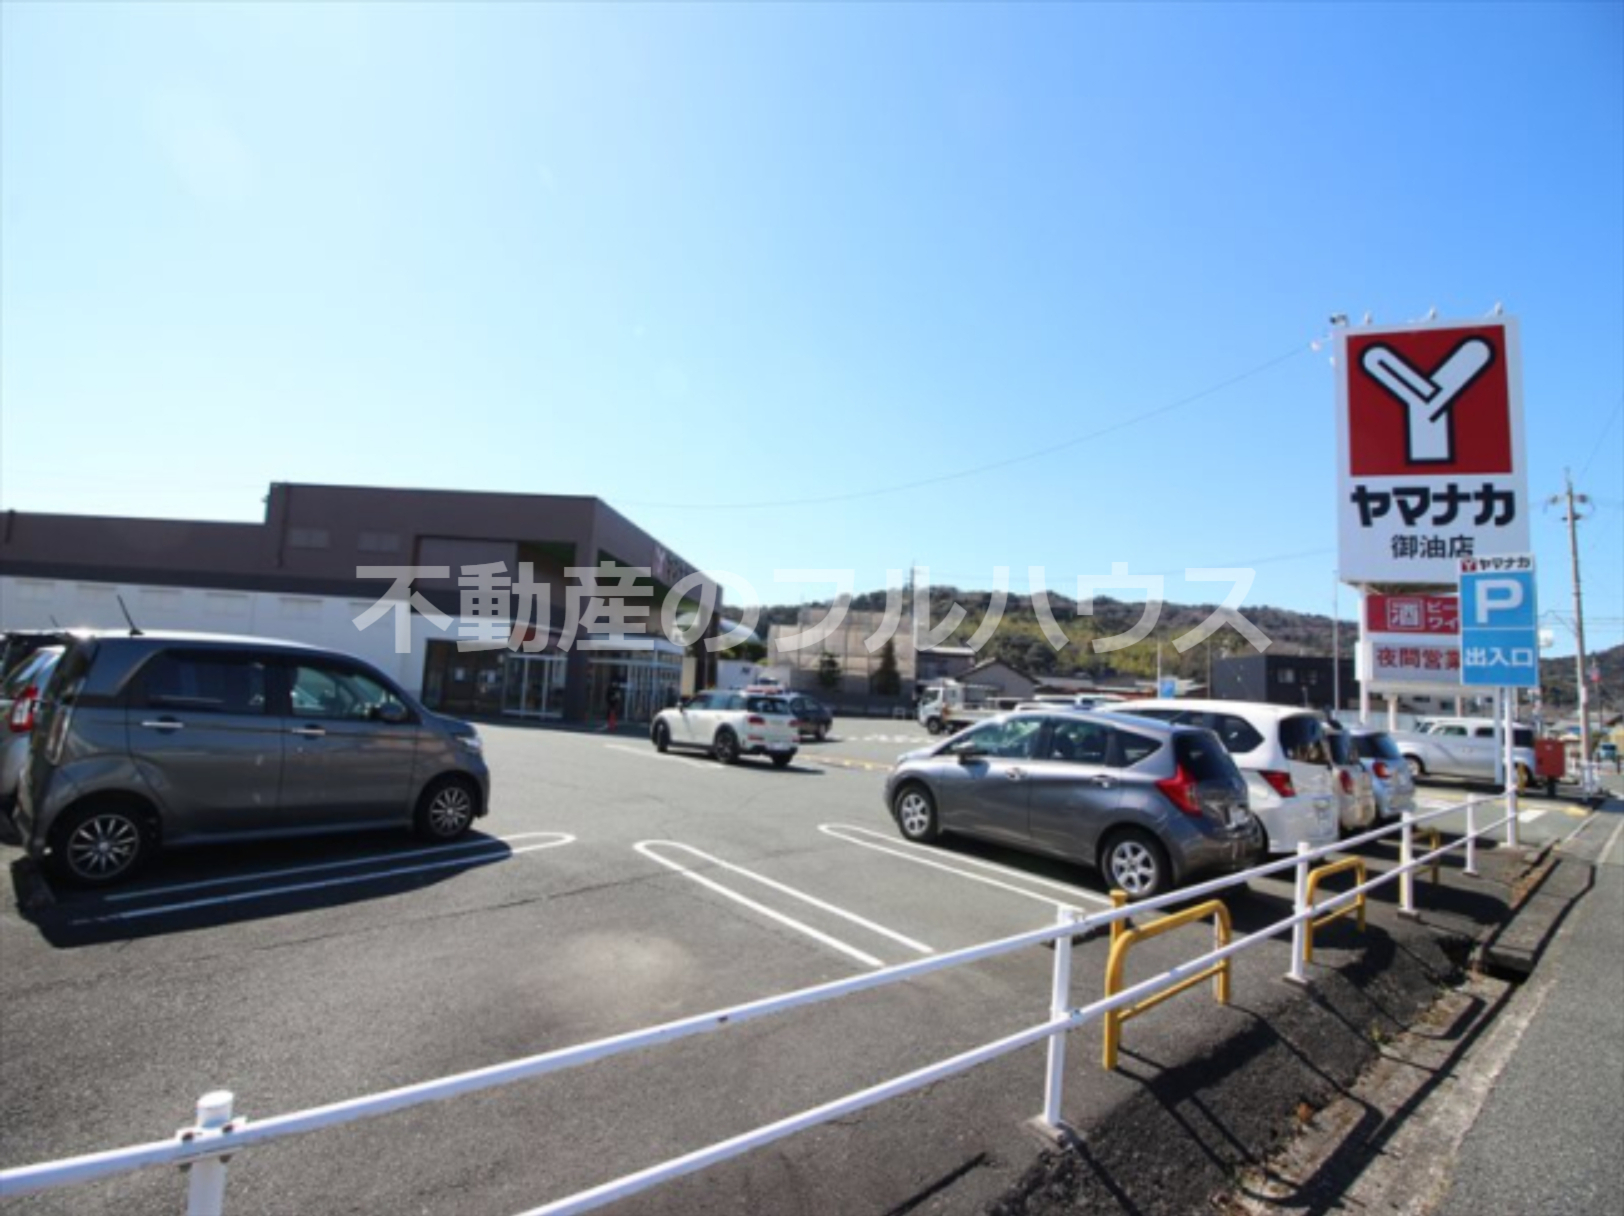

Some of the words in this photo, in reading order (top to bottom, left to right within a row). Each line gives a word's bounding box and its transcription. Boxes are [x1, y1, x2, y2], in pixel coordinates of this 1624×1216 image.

[1351, 483, 1515, 527] ヤマナカ
[1391, 534, 1475, 558] 御油店
[1479, 556, 1531, 571] ヤマナカ
[1391, 601, 1420, 627] 酒
[1475, 579, 1523, 624] P
[1465, 647, 1534, 668] 出入口
